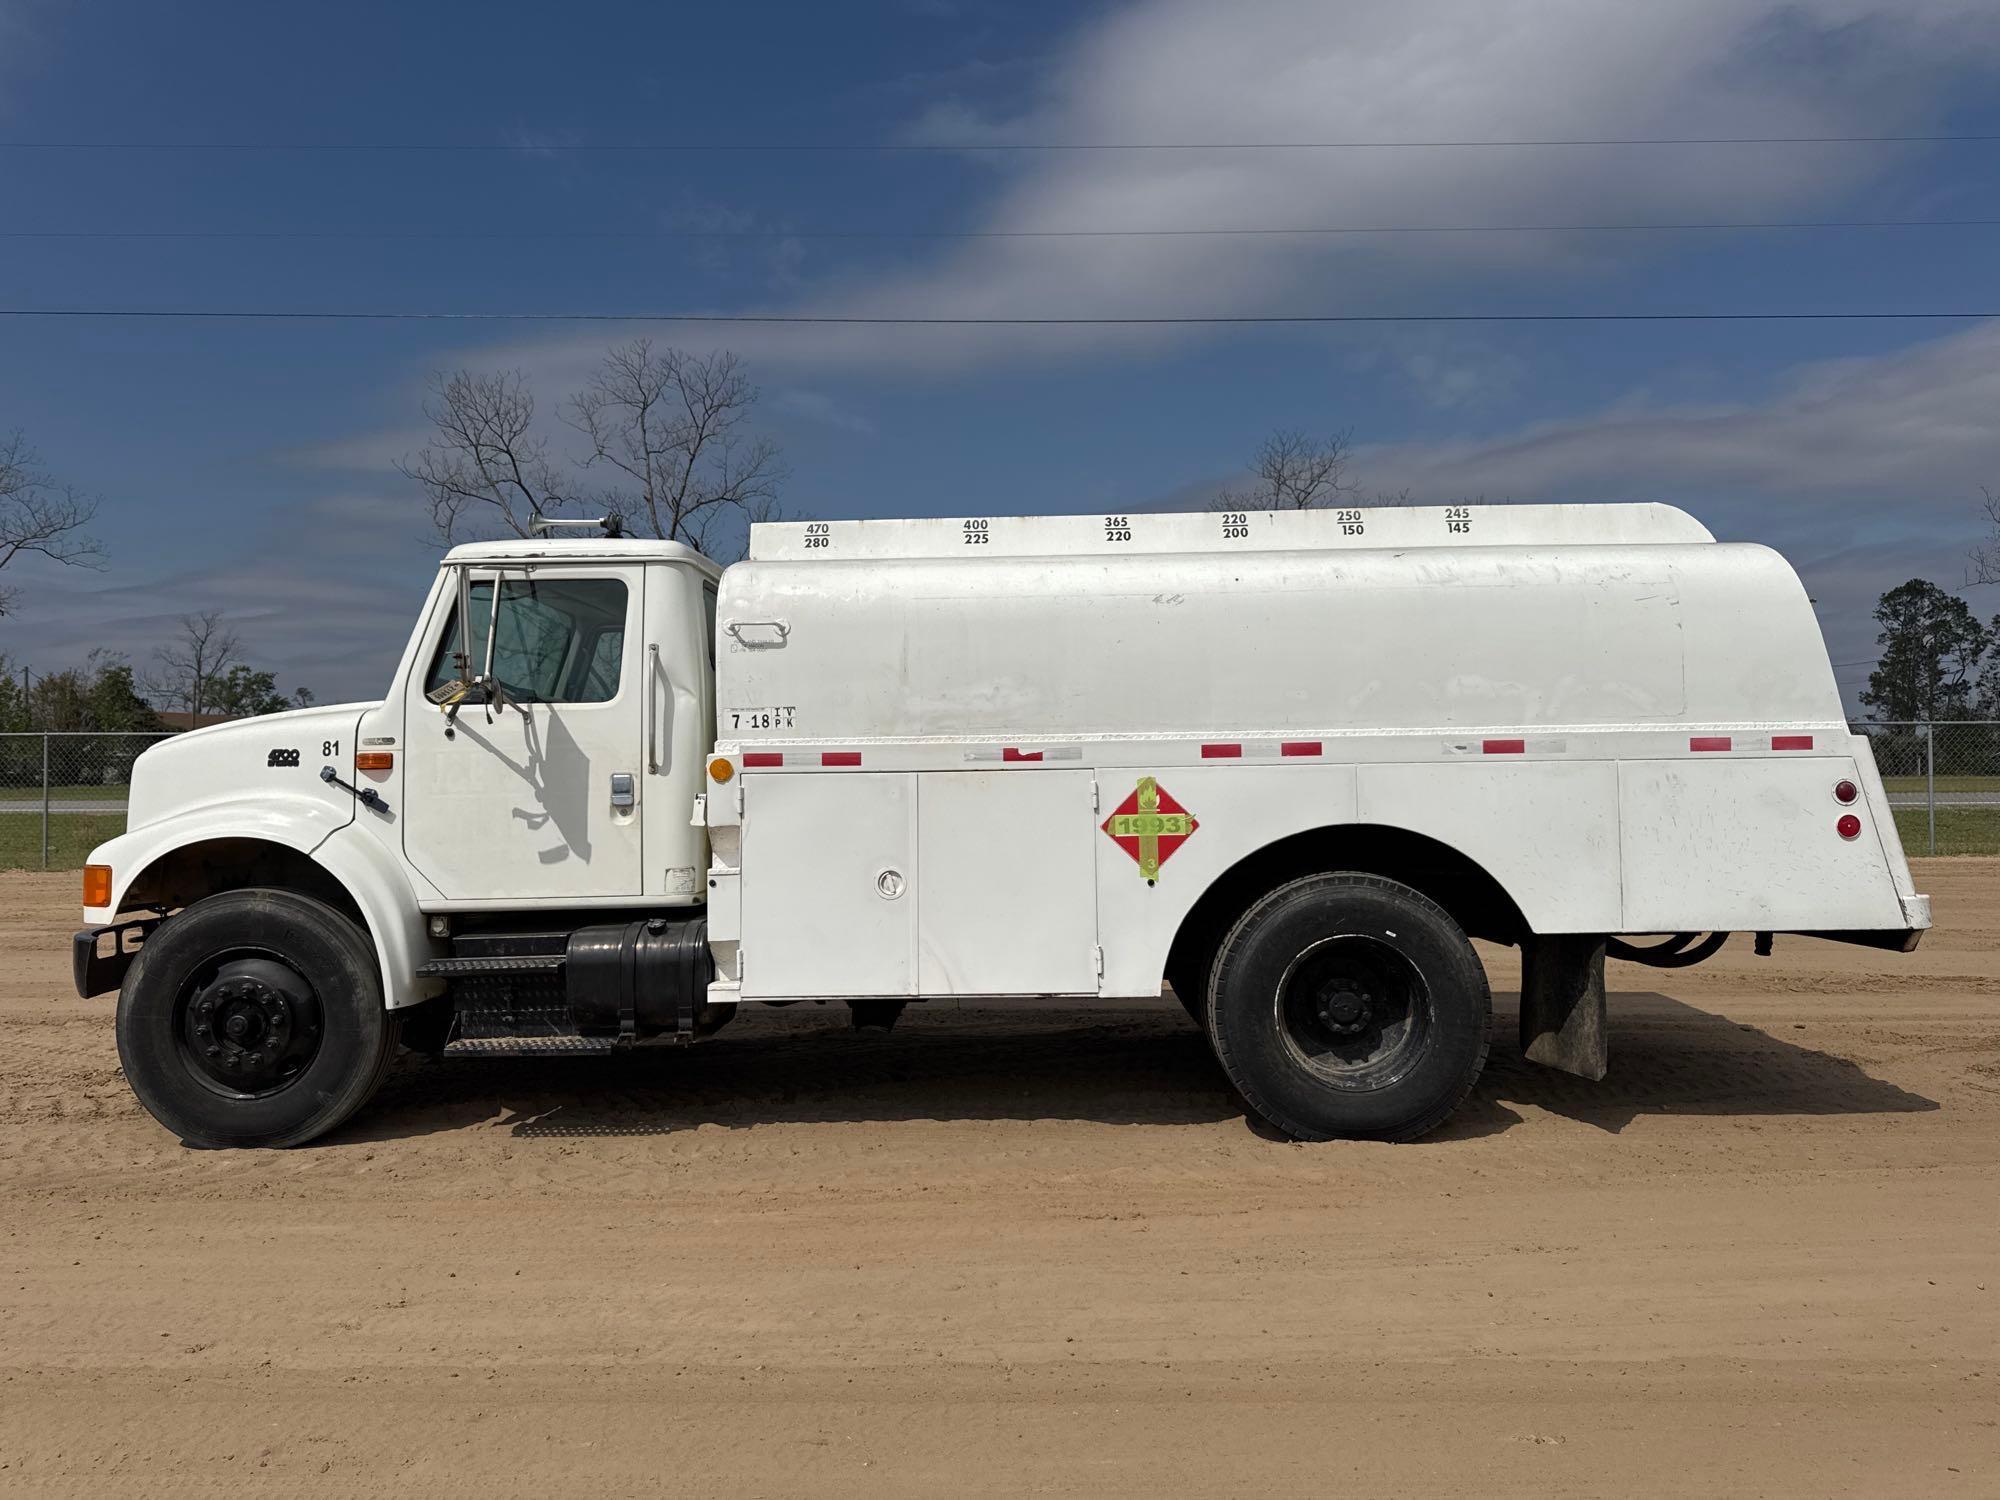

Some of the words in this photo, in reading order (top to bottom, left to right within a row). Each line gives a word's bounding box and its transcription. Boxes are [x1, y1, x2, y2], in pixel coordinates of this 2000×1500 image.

[1222, 514, 1247, 524] 220
[1337, 511, 1361, 521] 250
[1445, 508, 1470, 519] 245
[963, 519, 988, 530] 400
[1104, 517, 1128, 528] 365
[1447, 522, 1470, 533] 145
[806, 523, 829, 534] 470
[1223, 527, 1249, 538] 200
[1342, 525, 1364, 535] 150
[964, 533, 989, 544] 225
[1106, 531, 1131, 542] 220
[804, 537, 829, 548] 280
[322, 740, 339, 756] 81
[1118, 816, 1181, 834] 1993
[1147, 858, 1156, 869] 3
